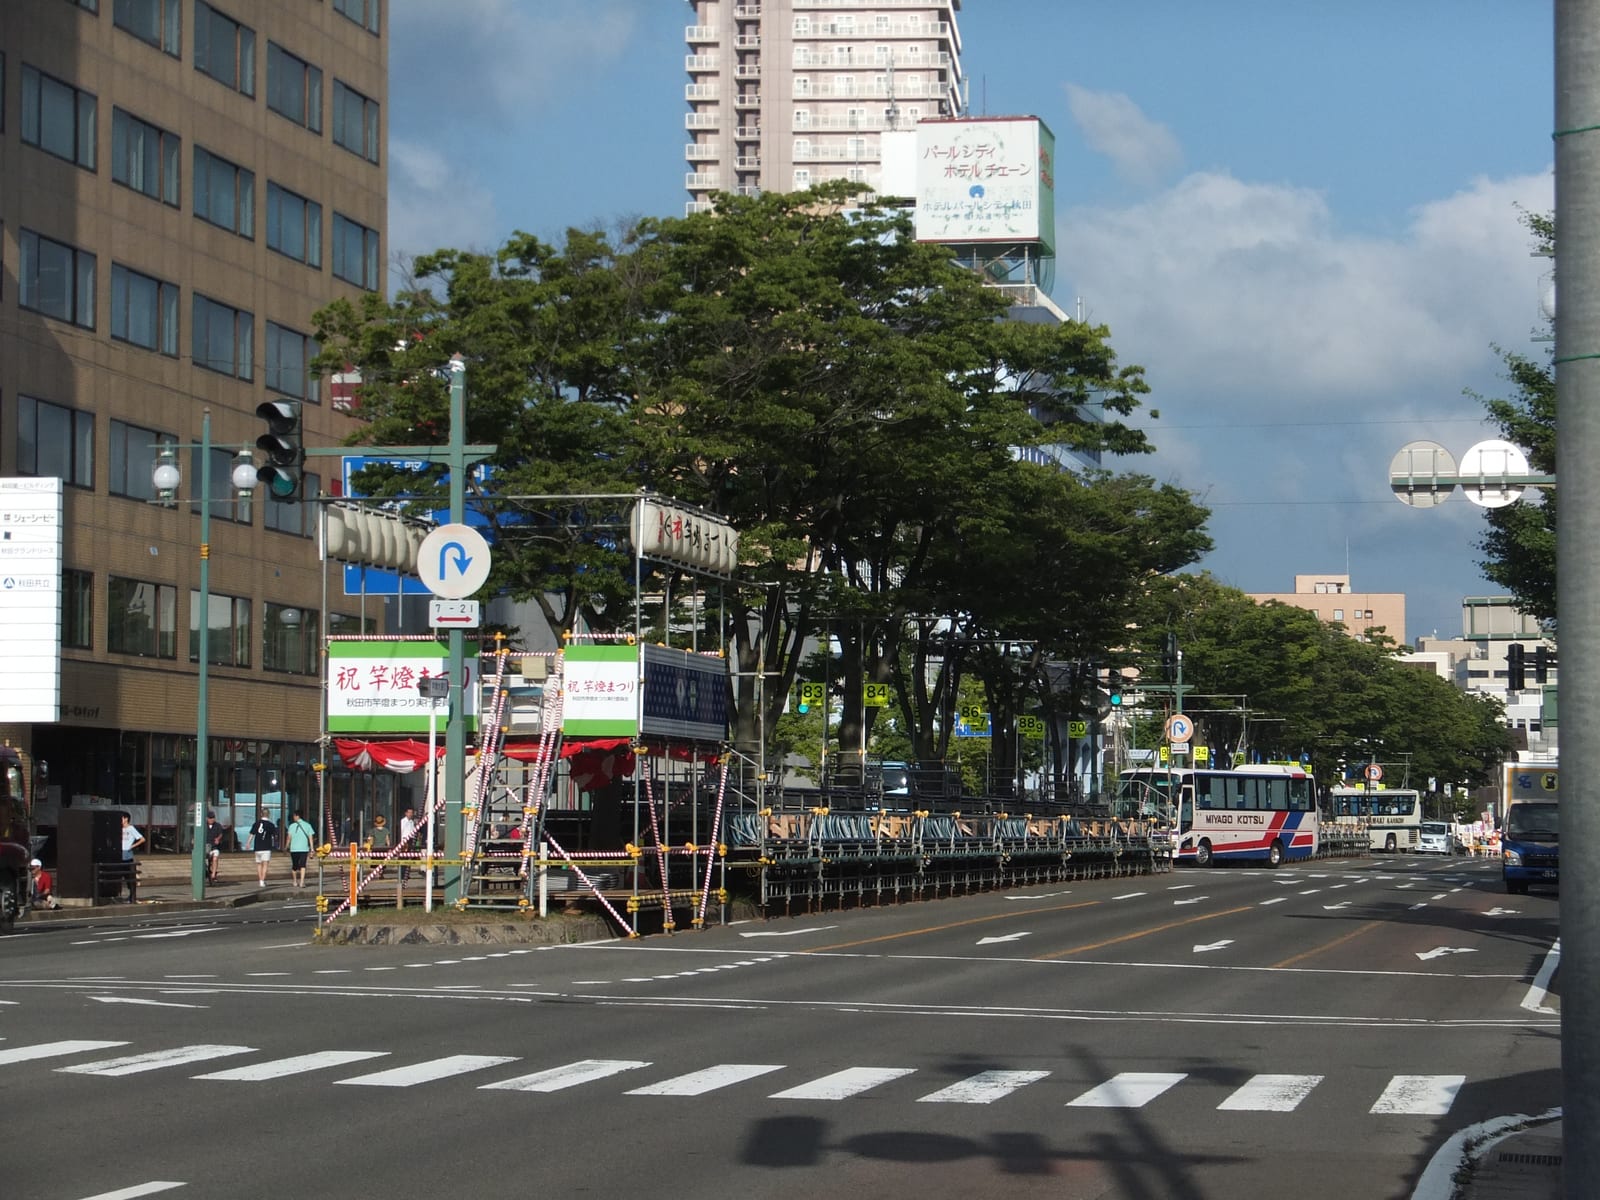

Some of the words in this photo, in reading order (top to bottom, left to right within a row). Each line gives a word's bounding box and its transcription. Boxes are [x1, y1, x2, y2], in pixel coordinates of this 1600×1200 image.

[923, 144, 996, 160] パールシティ
[944, 163, 1031, 178] ホテルチェーン
[336, 666, 361, 691] 祝
[568, 680, 580, 693] 祝
[584, 680, 634, 693] 竿燈まつり
[803, 685, 823, 698] 83
[866, 685, 886, 698] 84
[961, 706, 979, 718] 86
[1018, 717, 1035, 728] 88
[1069, 722, 1085, 732] 90
[1205, 815, 1233, 825] MIYAGO
[1237, 815, 1265, 825] KOTSU
